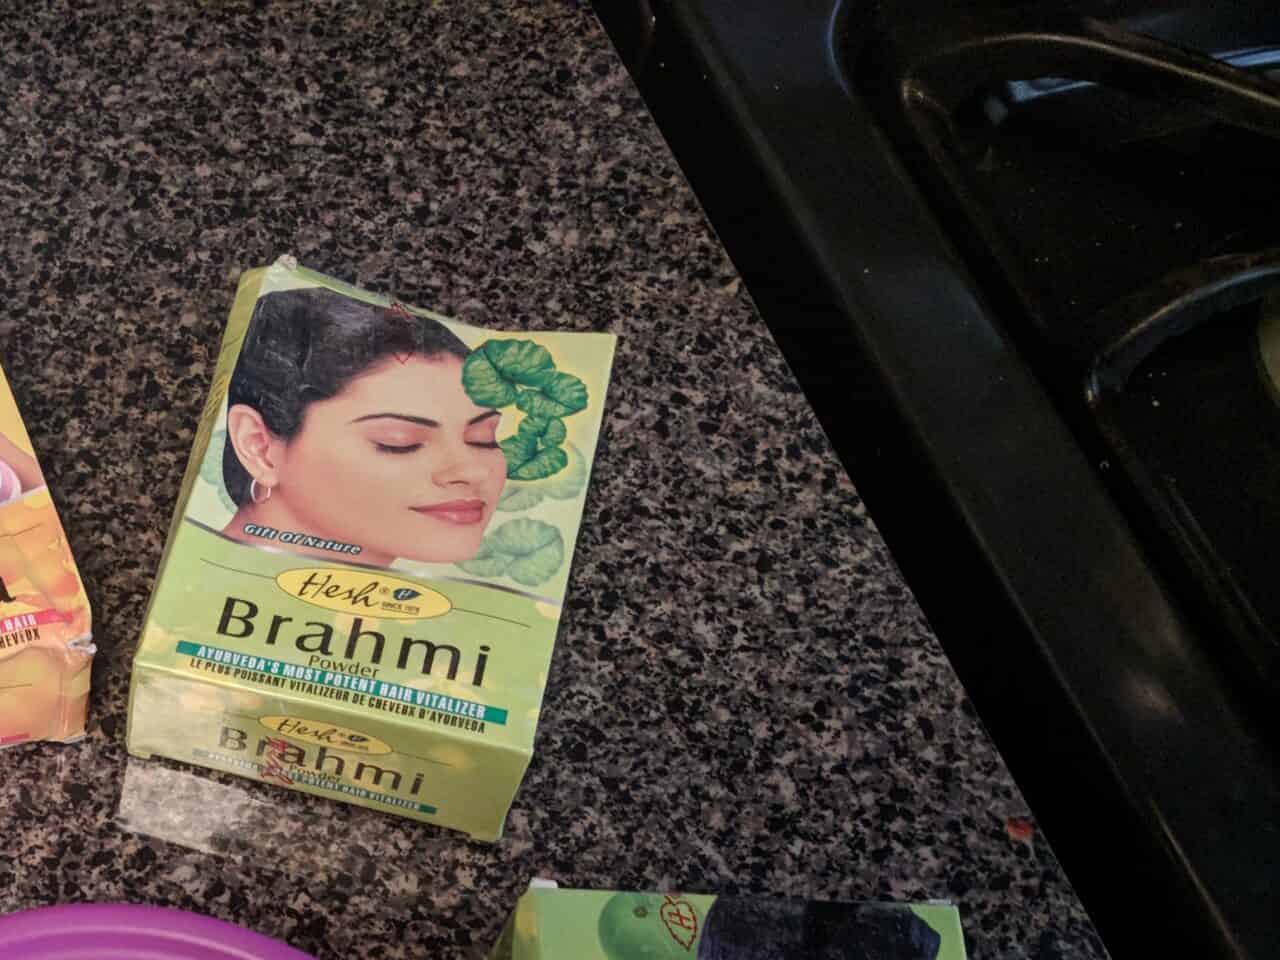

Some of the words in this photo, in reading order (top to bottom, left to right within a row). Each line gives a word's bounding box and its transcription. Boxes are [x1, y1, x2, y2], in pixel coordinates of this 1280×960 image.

[243, 523, 278, 539] Gift
[279, 531, 303, 546] Of
[302, 535, 362, 557] Nature
[297, 572, 381, 608] Hesh
[3, 613, 38, 632] HAIR
[215, 596, 492, 688] Brahmi
[196, 645, 281, 674] AYURVEDA'S
[282, 664, 324, 683] MOST
[323, 672, 377, 695] POTENT
[378, 681, 414, 702] HAIR
[415, 692, 486, 719] VITALIZER
[307, 654, 381, 679] Powder
[189, 658, 202, 669] LE
[204, 660, 232, 676] PLUS
[288, 678, 351, 702] VITALIZEUR
[351, 693, 366, 706] DE
[367, 696, 416, 720] CHEVEUX
[418, 706, 486, 734] D'AYURVEDA
[219, 726, 425, 796] Brahmi
